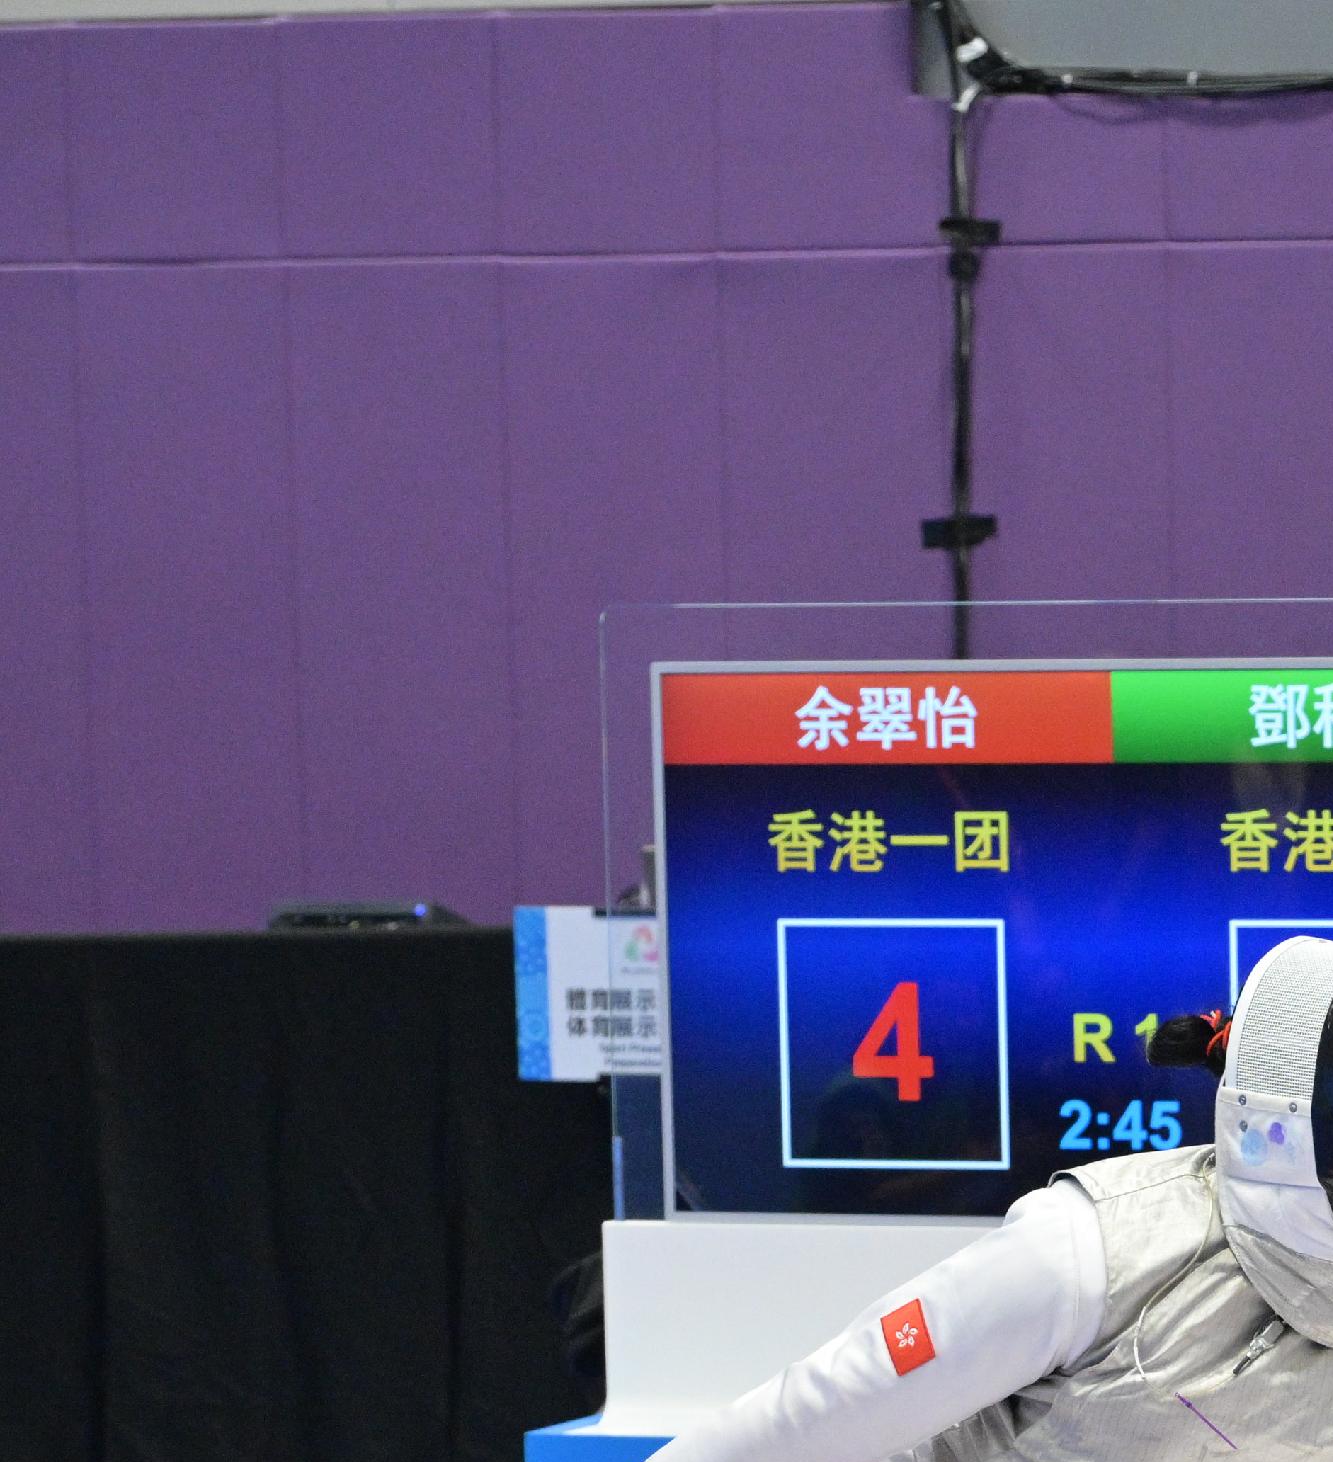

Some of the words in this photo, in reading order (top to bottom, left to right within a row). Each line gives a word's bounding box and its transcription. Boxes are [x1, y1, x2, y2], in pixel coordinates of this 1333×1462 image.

[795, 686, 978, 751] 余翠怡
[768, 810, 1010, 873] 香港一团
[851, 981, 935, 1102] 4
[1073, 1013, 1115, 1062] R
[1059, 1100, 1182, 1151] 2:45
